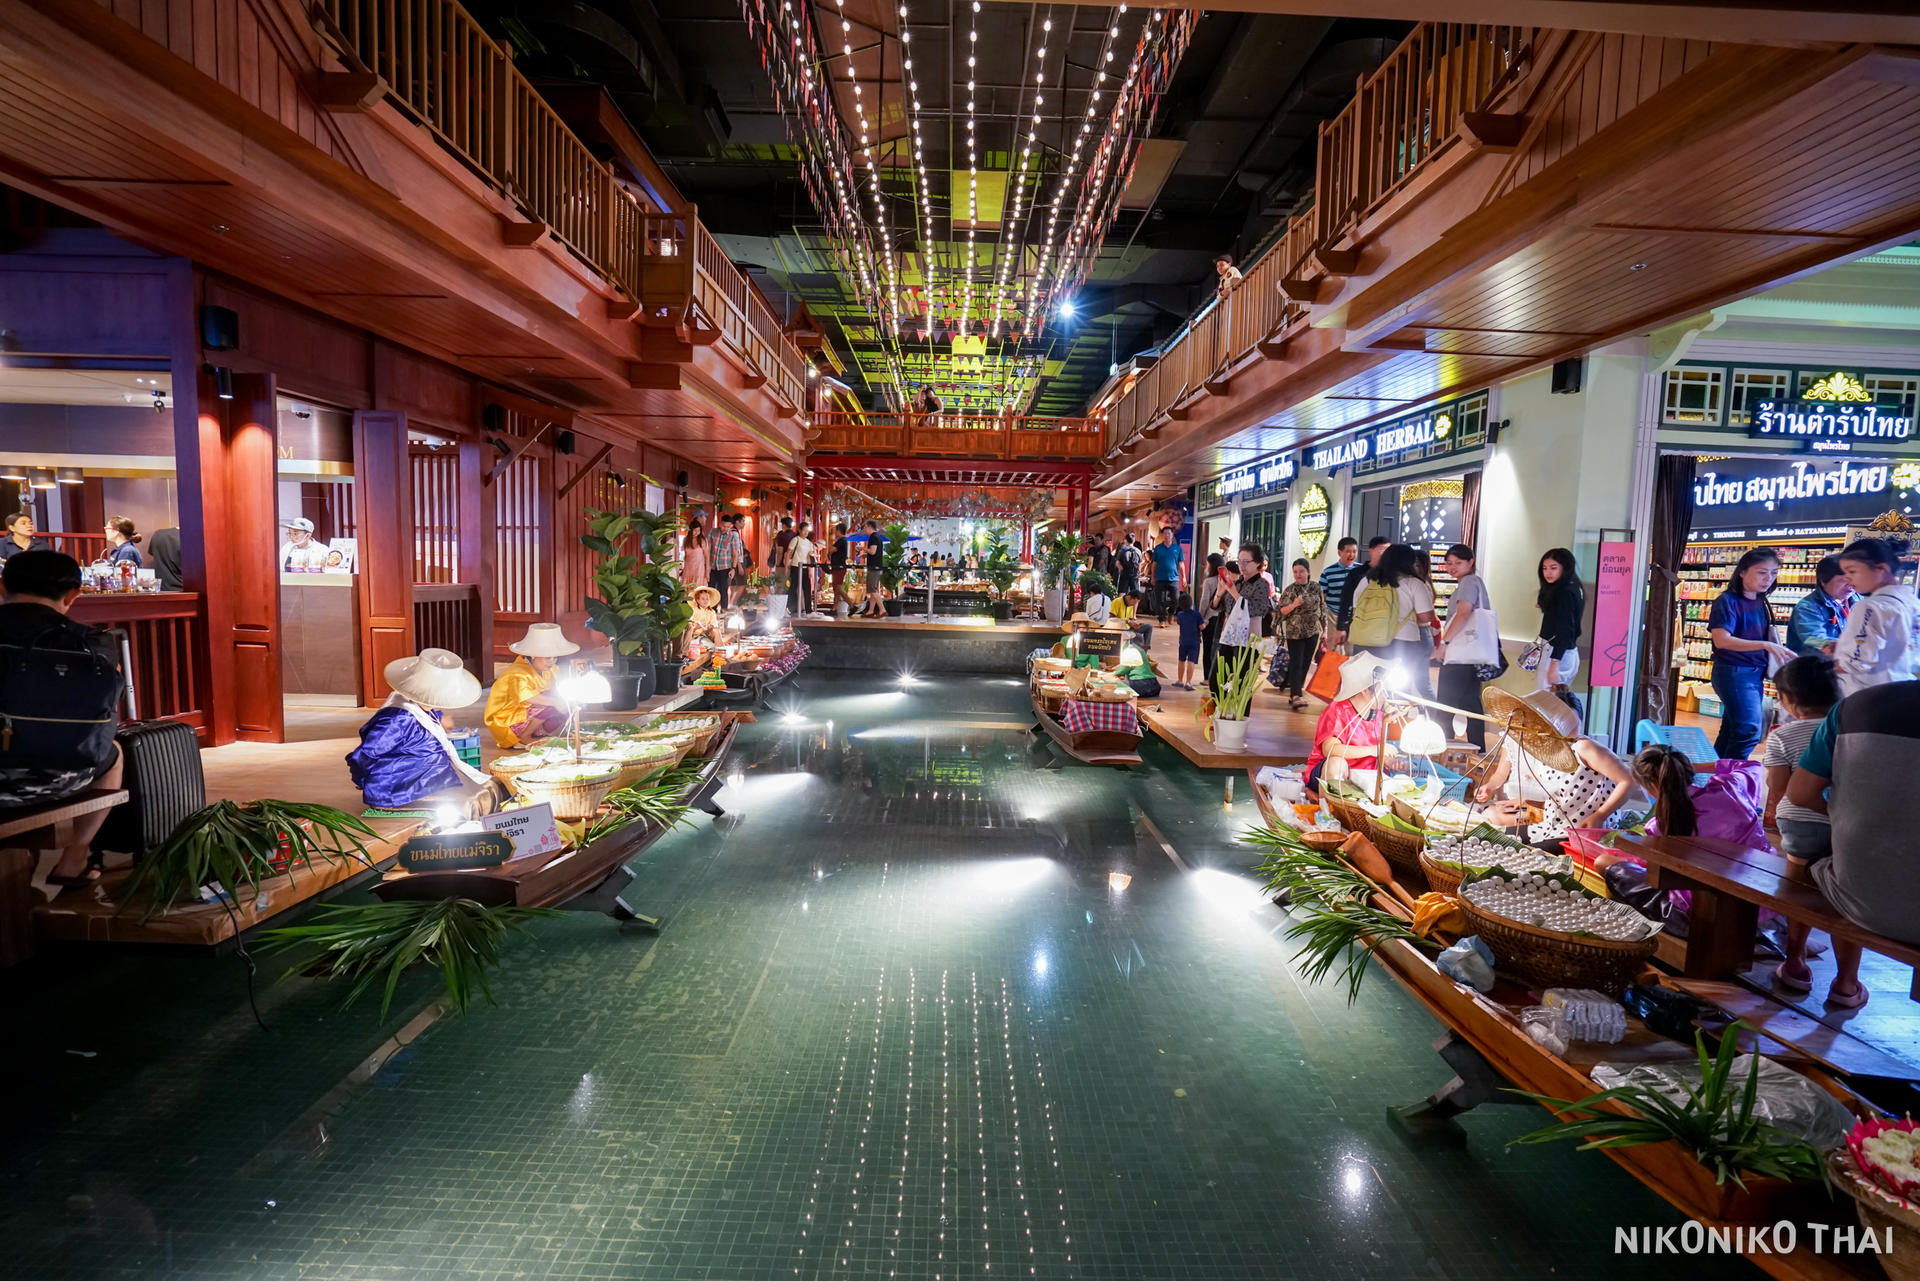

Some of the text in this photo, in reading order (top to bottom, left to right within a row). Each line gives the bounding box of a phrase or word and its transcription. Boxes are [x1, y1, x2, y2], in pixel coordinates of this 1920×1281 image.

[1758, 402, 1909, 438] ร้านตำรับไทย
[1313, 420, 1434, 470] THAILAND HERBAL
[1694, 460, 1887, 510] บไทย สมุนไพรไทย
[495, 816, 529, 830] ขนมไทย
